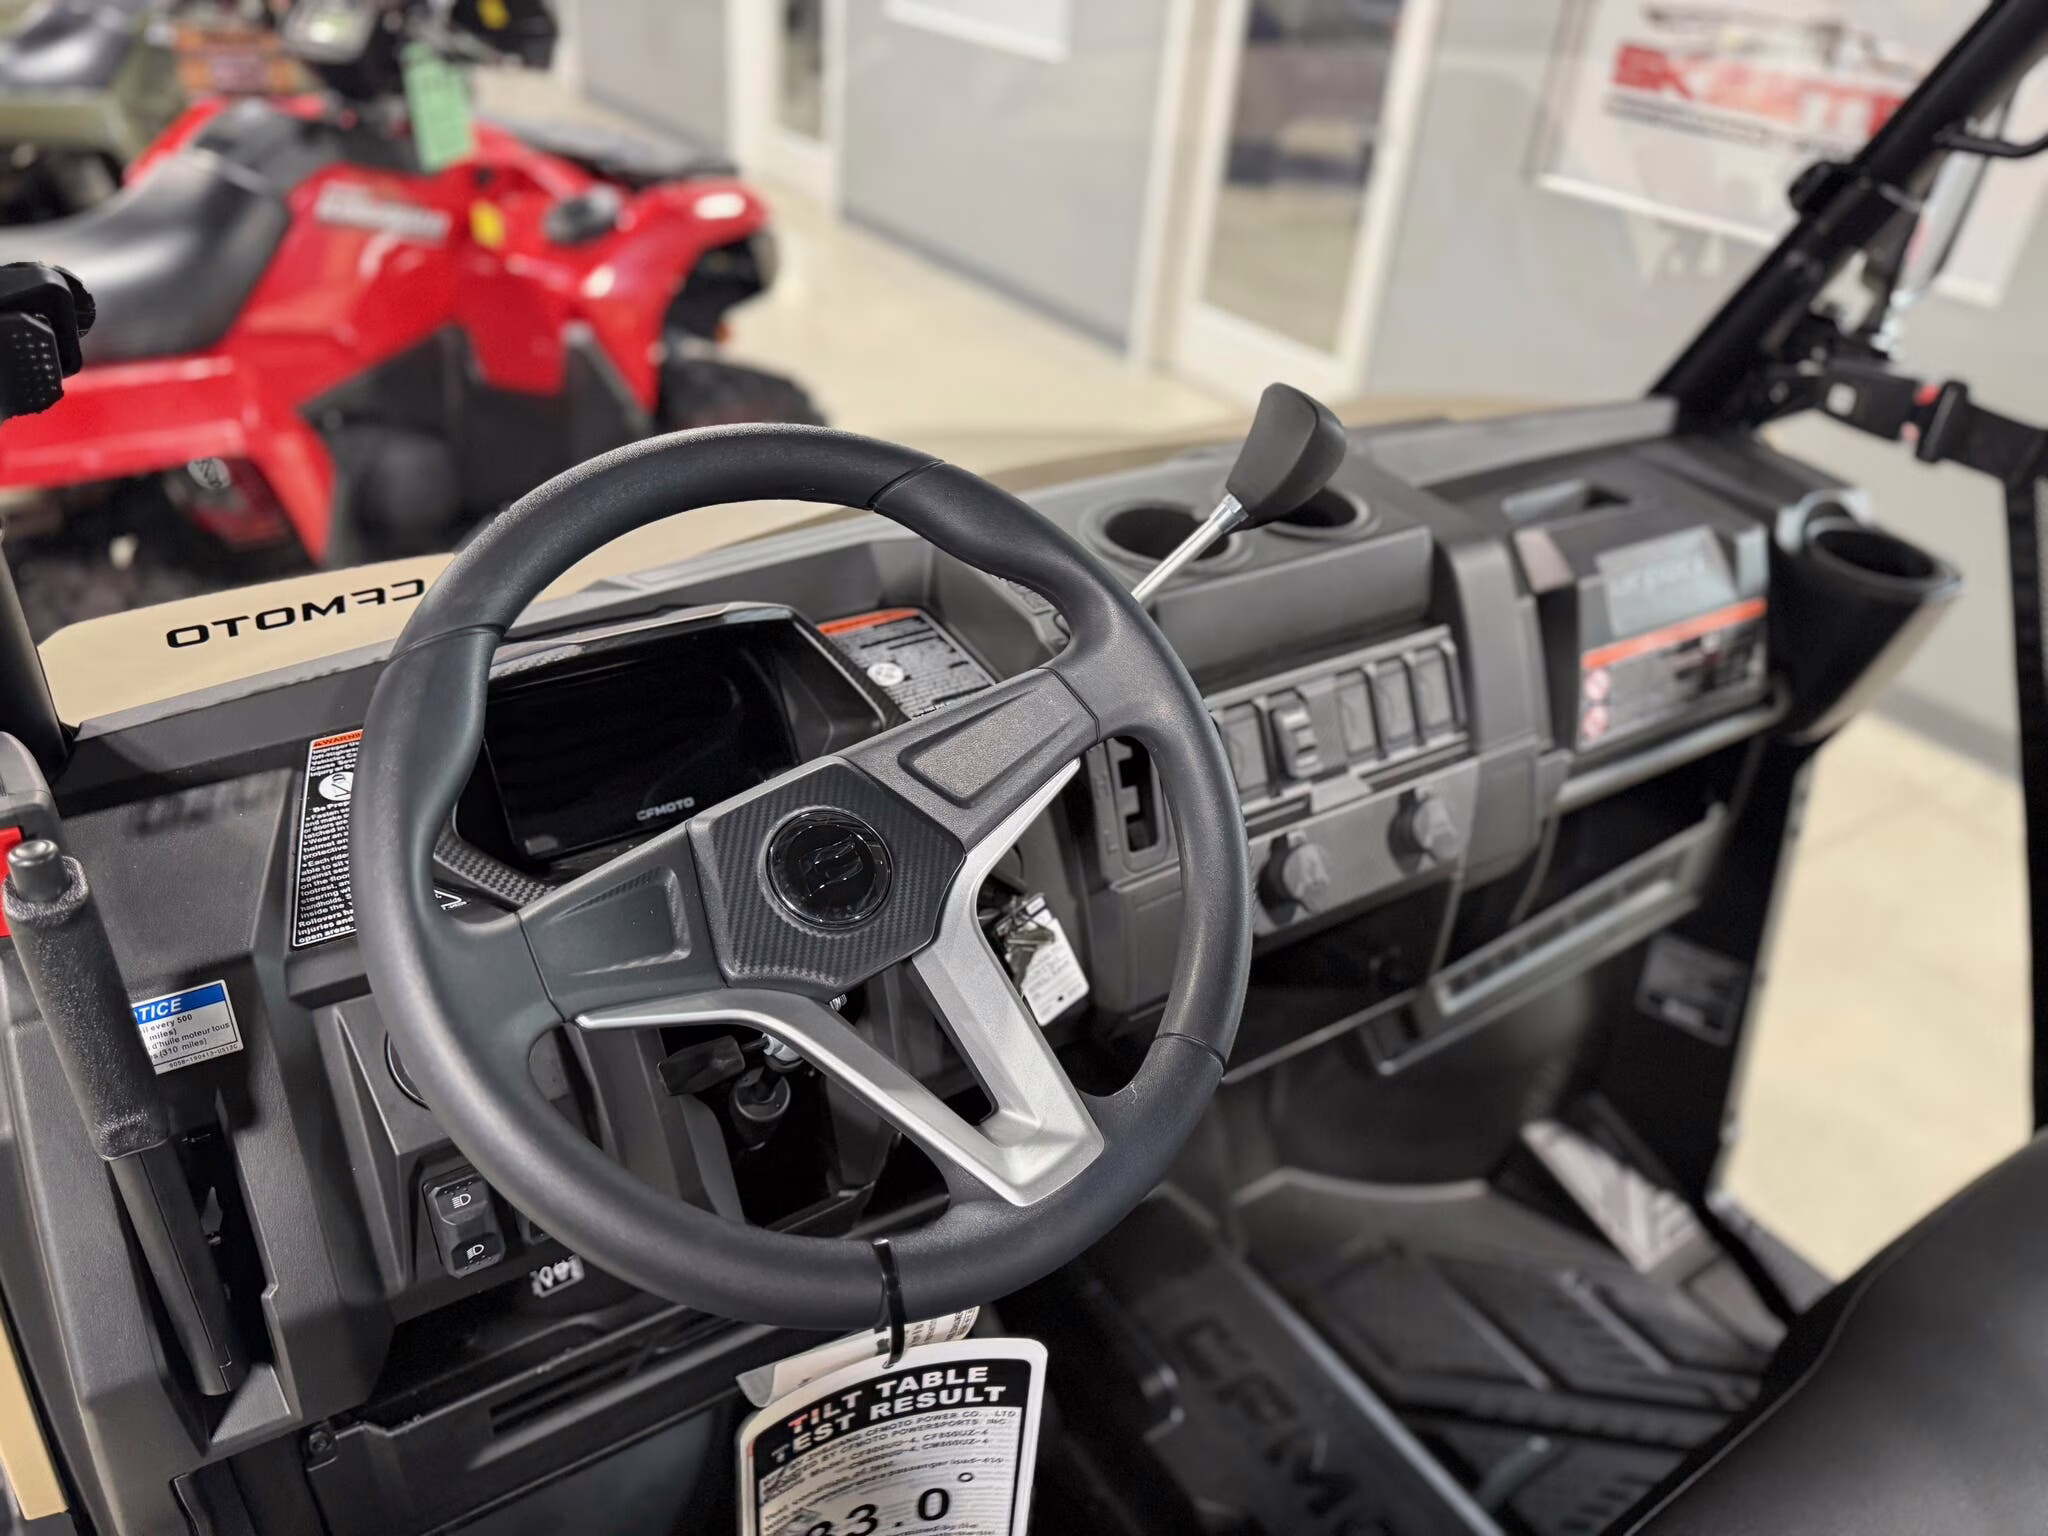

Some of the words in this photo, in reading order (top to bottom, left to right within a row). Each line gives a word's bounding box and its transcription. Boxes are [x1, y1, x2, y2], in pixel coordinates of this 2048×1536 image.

[310, 763, 336, 772] Cause
[311, 755, 346, 766] Vehicles
[310, 768, 334, 778] Injury
[326, 801, 351, 810] Prep
[637, 797, 695, 821] CFMOTO
[304, 820, 320, 828] and
[320, 814, 343, 824] make
[311, 809, 340, 820] Fasten
[303, 827, 336, 839] latched
[312, 823, 335, 831] doors
[303, 841, 336, 853] helmet
[308, 835, 330, 845] Wear
[302, 845, 348, 861] protective
[301, 867, 321, 876] able
[332, 860, 344, 868] sit
[307, 858, 330, 867] Each
[300, 870, 332, 883] against
[313, 879, 328, 887] the
[300, 890, 339, 904] steering
[300, 907, 328, 919] inside
[329, 903, 345, 911] the
[297, 922, 335, 936] injuries
[336, 915, 354, 925] and
[298, 912, 343, 928] Rollovers
[298, 932, 323, 943] open
[324, 924, 354, 936] areas.
[134, 998, 182, 1022] TICE
[150, 1020, 175, 1031] every
[177, 1014, 193, 1024] 500
[149, 1028, 177, 1041] miles)
[152, 1038, 180, 1050] d'huile
[181, 1028, 211, 1041] moteur
[212, 1022, 231, 1032] tous
[159, 1046, 178, 1059] (310
[181, 1038, 208, 1051] miles)
[788, 1390, 863, 1434] TILT
[876, 1366, 989, 1398] TABLE
[771, 1412, 857, 1463] TEST
[870, 1386, 1007, 1420] RESULT
[865, 1419, 912, 1437] CFMOTO
[916, 1412, 958, 1424] POWER
[840, 1433, 888, 1453] CFMOTO
